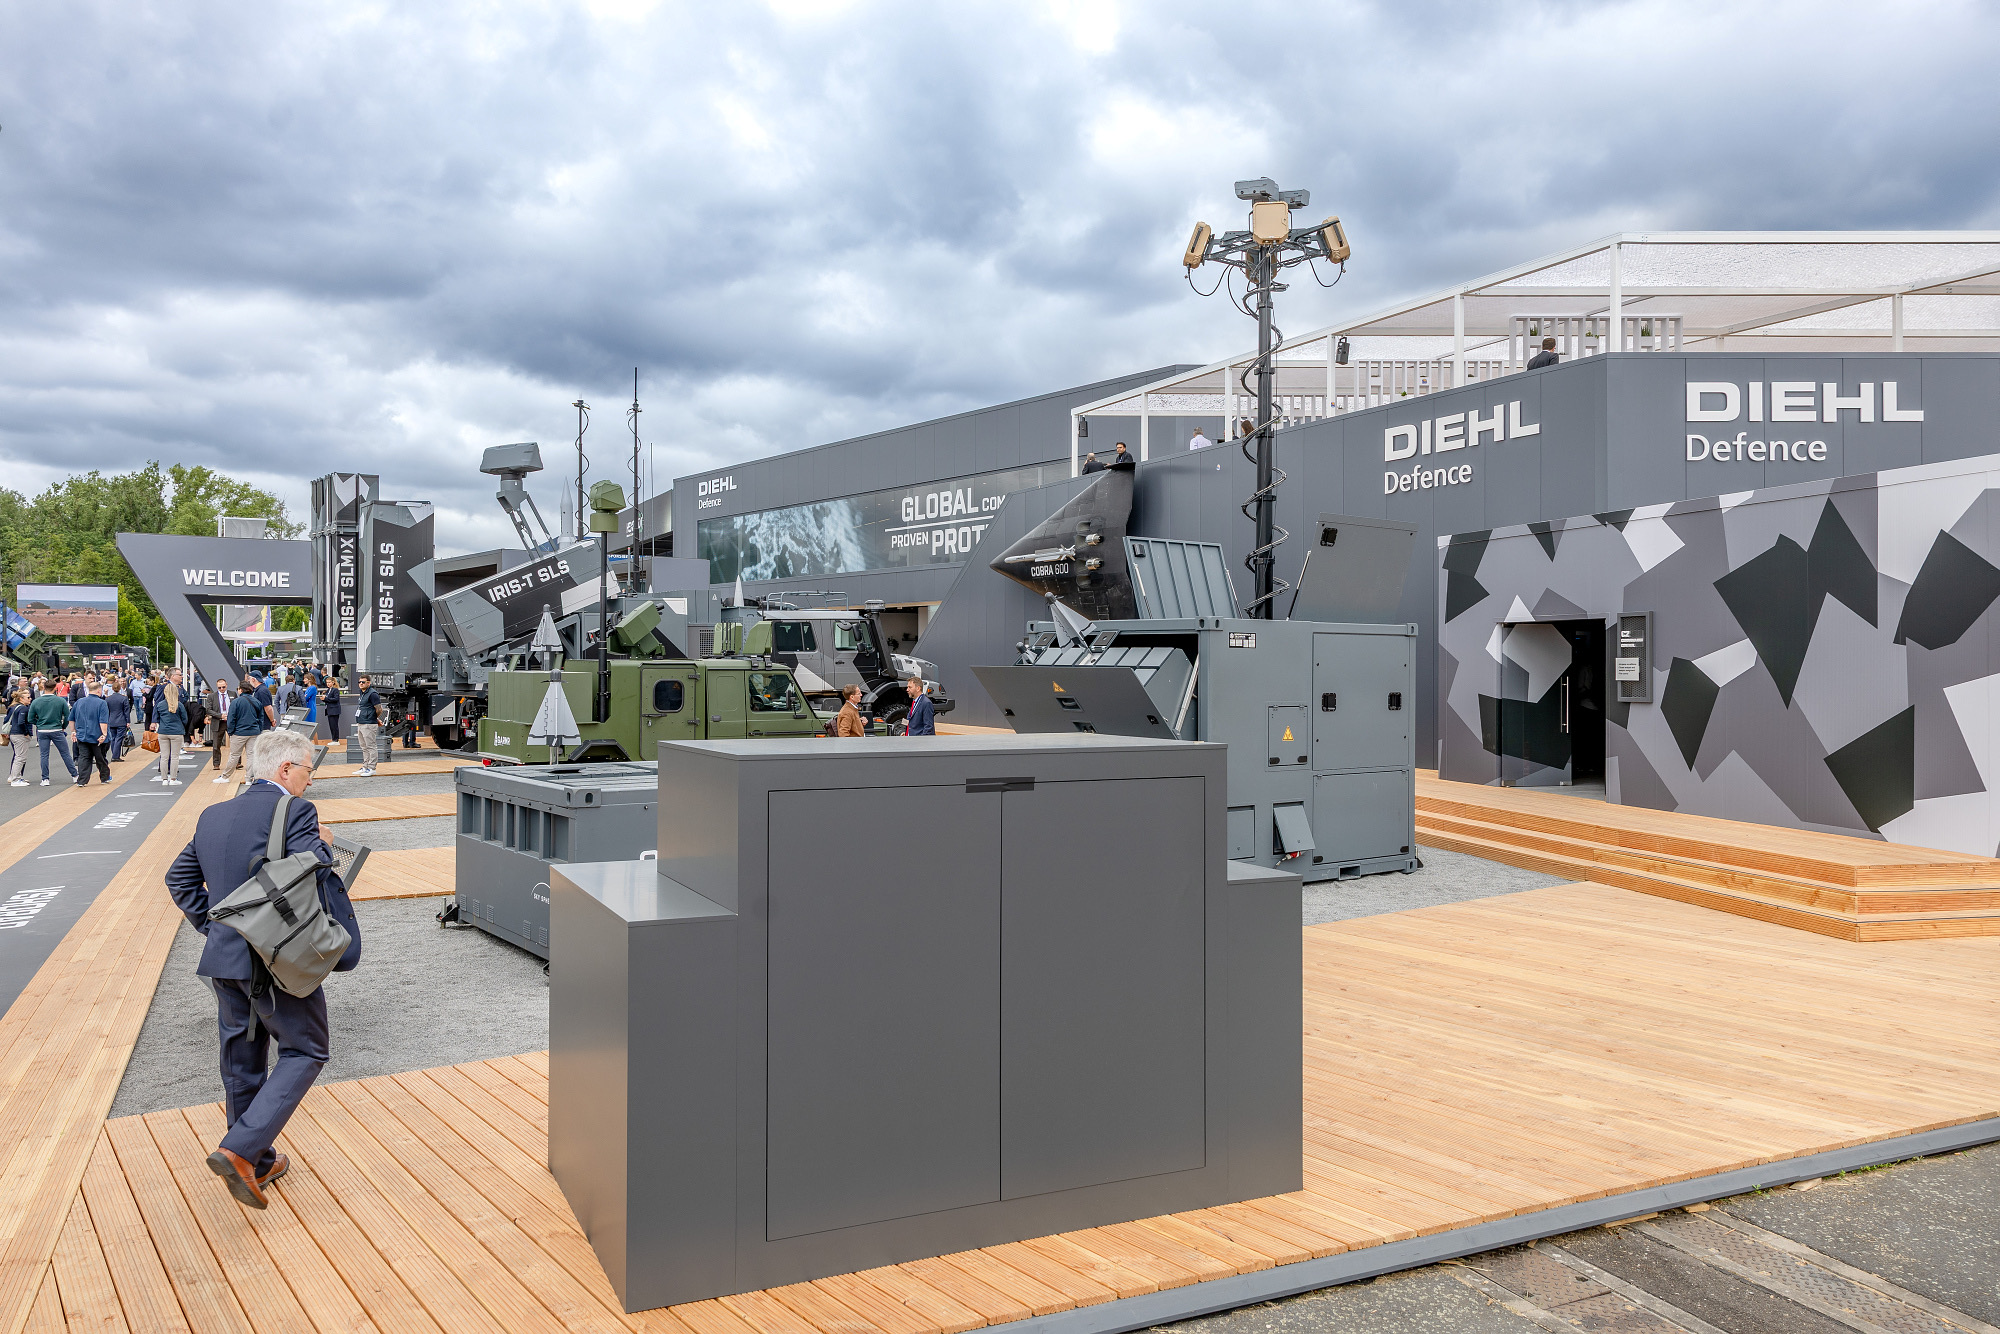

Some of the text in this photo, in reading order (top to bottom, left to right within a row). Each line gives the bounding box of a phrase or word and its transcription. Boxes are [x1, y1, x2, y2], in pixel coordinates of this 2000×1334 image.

[1686, 380, 1925, 423] DIEHL
[1384, 400, 1541, 463] DIEHL
[1686, 432, 1828, 463] Defence
[698, 475, 738, 497] DIEHL
[1383, 463, 1473, 496] Defence
[698, 498, 722, 510] Defence
[901, 487, 979, 522] GLOBAL
[891, 531, 929, 549] PROVEN
[182, 568, 290, 588] WELCOME
[378, 542, 395, 630] IRIS-T SLS
[488, 559, 570, 602] IRIS-T SLS
[1030, 563, 1069, 577] COBRA 600
[340, 591, 355, 636] IRIS-T
